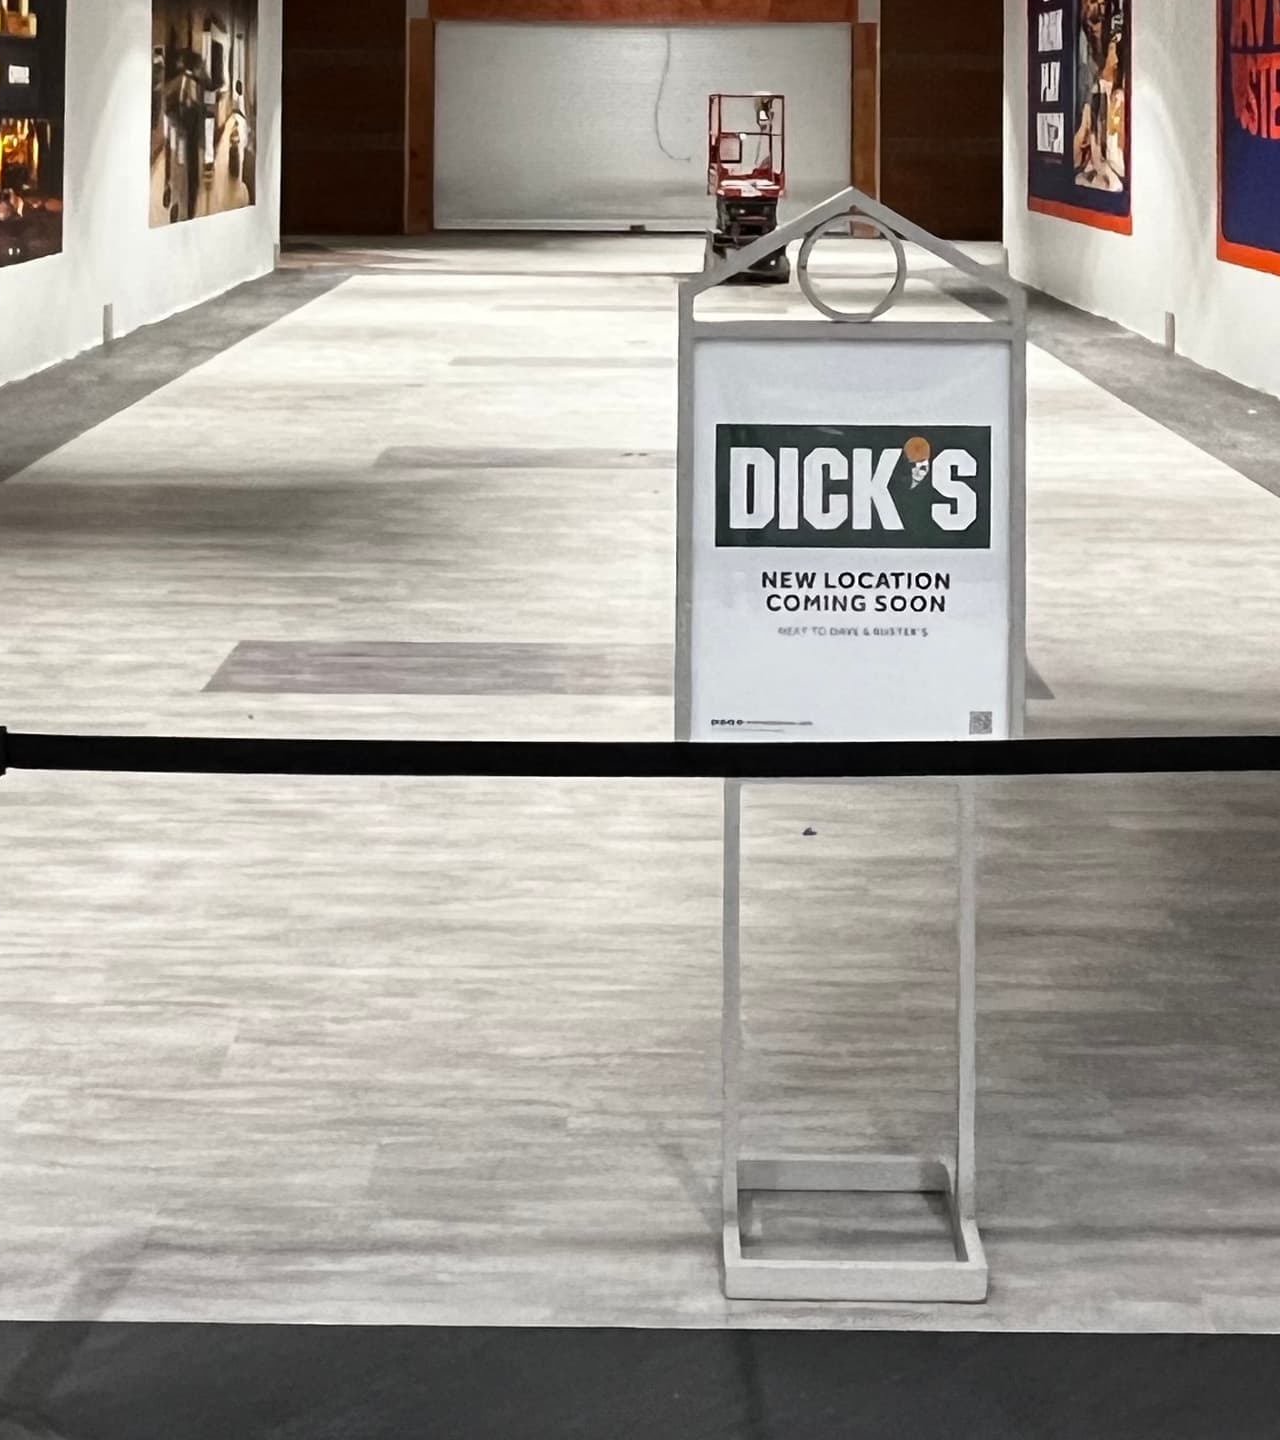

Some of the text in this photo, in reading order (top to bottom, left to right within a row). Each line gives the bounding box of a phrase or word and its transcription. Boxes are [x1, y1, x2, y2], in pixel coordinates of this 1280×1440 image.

[729, 438, 978, 531] DICK'S
[761, 571, 951, 591] NEW LOCATION
[766, 594, 946, 613] COMING SOON
